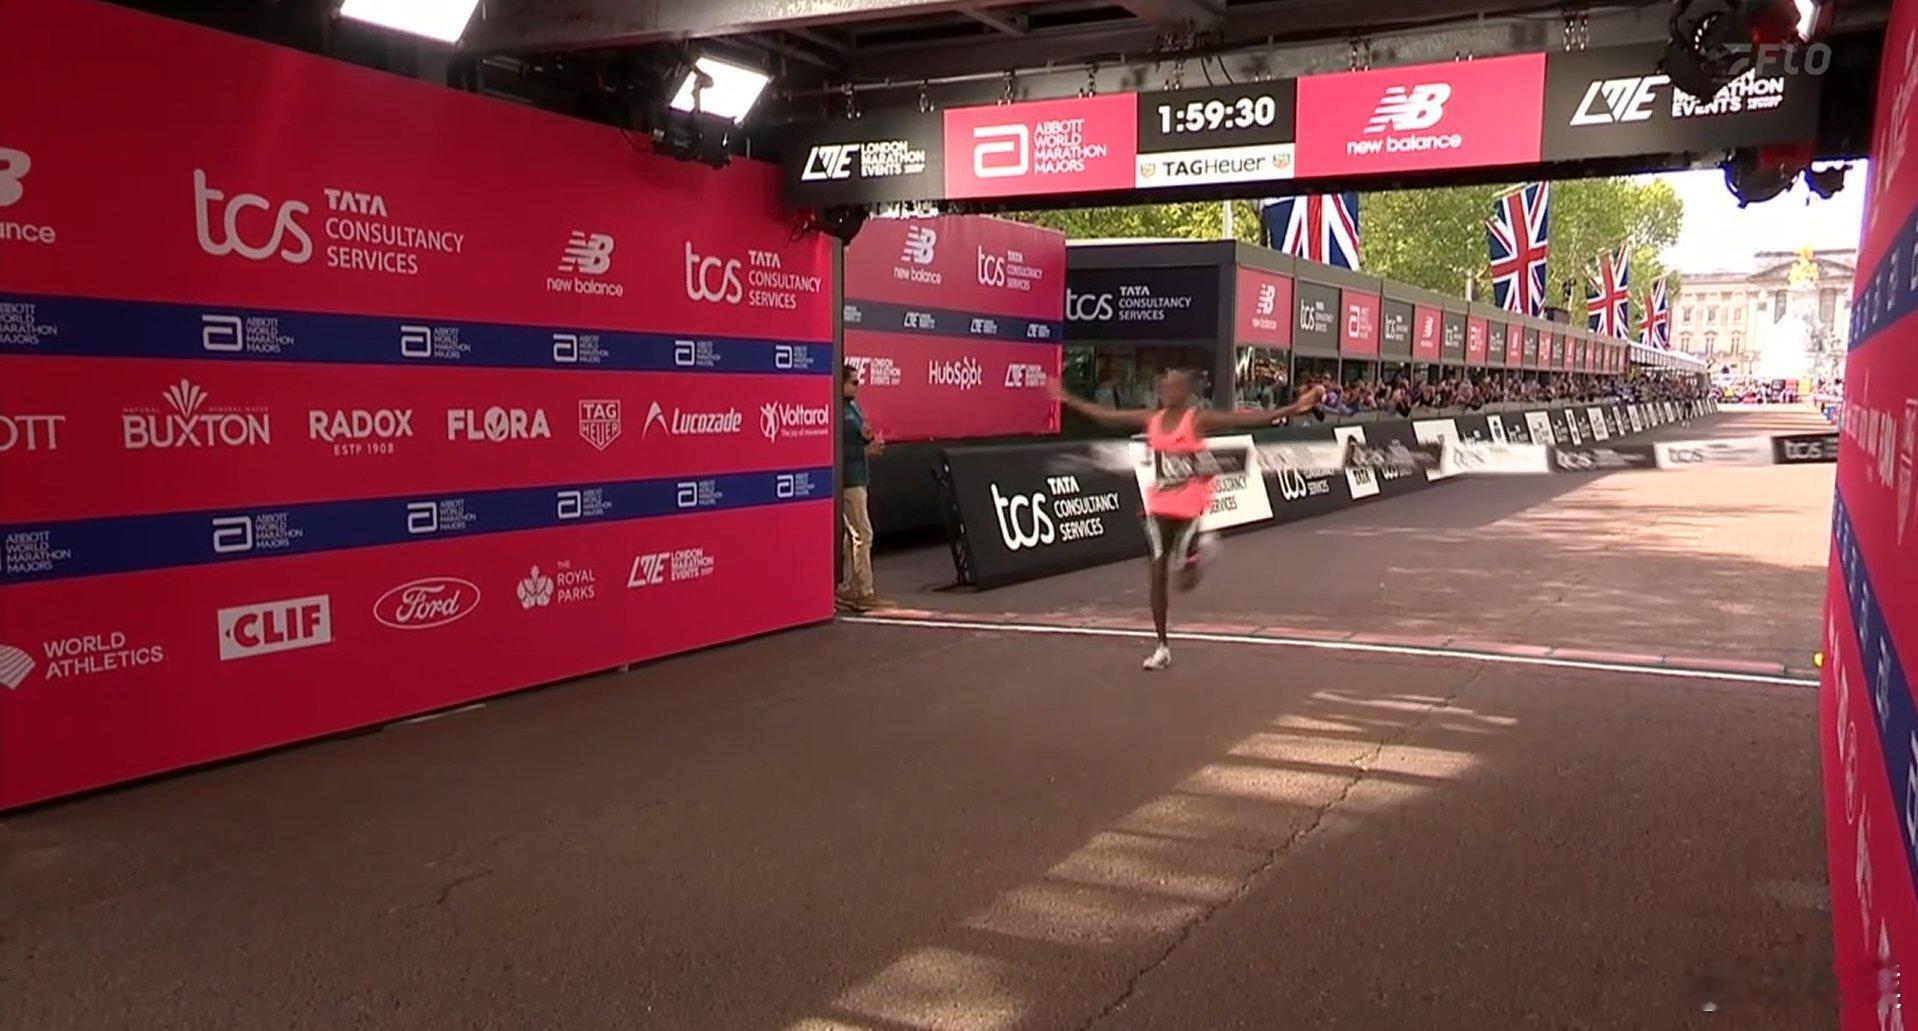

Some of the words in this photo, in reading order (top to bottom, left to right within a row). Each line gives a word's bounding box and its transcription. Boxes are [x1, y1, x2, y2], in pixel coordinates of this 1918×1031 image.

[1035, 118, 1084, 134] ABBOTT
[1157, 95, 1275, 134] 1:59:30
[861, 140, 908, 154] LONDON
[1034, 132, 1082, 148] WORLD
[1347, 138, 1382, 156] new
[1386, 132, 1462, 154] balance
[861, 150, 925, 165] MARATHON
[1035, 144, 1107, 160] MARATHON
[861, 163, 902, 177] EVENTS
[1035, 158, 1085, 174] MAJORS
[324, 188, 388, 218] TATA
[193, 168, 313, 264] tcs
[325, 217, 464, 253] CONSULTANCY
[327, 245, 418, 276] SERVICES
[748, 249, 781, 268] TATA
[977, 244, 1005, 287] tcs
[685, 240, 744, 305] tcs
[748, 270, 822, 293] CONSULTANCY
[894, 266, 910, 280] new
[912, 267, 942, 285] balance
[546, 277, 572, 292] new
[574, 277, 624, 297] balance
[1119, 285, 1150, 297] TATA
[748, 290, 797, 310] SERVICES
[1065, 288, 1113, 322] tcs
[1119, 296, 1192, 309] CONSULTANCY
[1119, 309, 1165, 321] SERVICES
[928, 356, 982, 390] HubSpot
[583, 404, 617, 419] TAG
[671, 407, 742, 435] Lucozade
[780, 403, 829, 426] Voltarol
[122, 413, 270, 449] BUXTON
[308, 408, 414, 442] RADOX
[447, 406, 551, 442] FLORA
[367, 442, 394, 455] 1908
[1047, 475, 1080, 495] TATA
[991, 482, 1055, 551] tcs
[1053, 492, 1120, 520] CONSULTANCY
[1059, 517, 1104, 542] SERVICES
[557, 560, 571, 569] THE
[557, 569, 596, 587] ROYAL
[395, 583, 460, 623] Ford
[558, 584, 596, 603] PARKS
[233, 603, 321, 649] CLIF
[43, 631, 126, 659] WORLD
[45, 645, 164, 681] ATHLETICS
